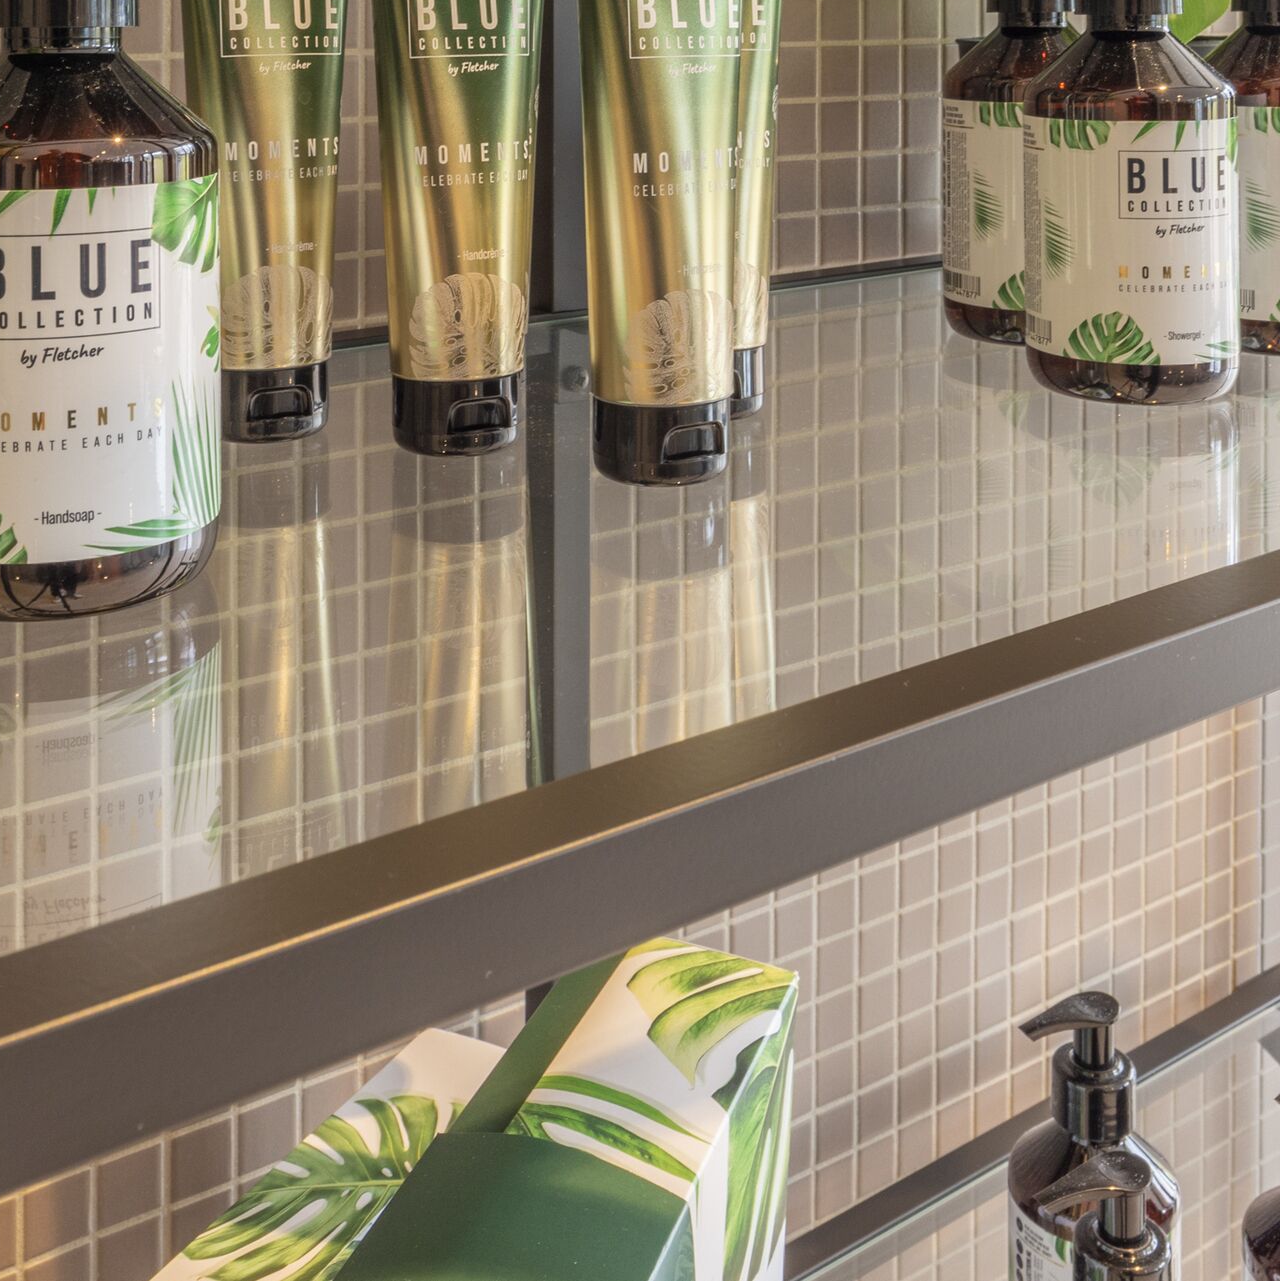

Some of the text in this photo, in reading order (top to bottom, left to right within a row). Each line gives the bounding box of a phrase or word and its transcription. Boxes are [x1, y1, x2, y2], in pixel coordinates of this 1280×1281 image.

[230, 35, 339, 50] COLLECTION
[419, 35, 527, 51] COLLECTION
[639, 34, 739, 51] COLLECTION
[448, 60, 500, 76] by Fletcher
[225, 136, 339, 161] MOMENTS
[414, 140, 529, 165] MOMENTS
[417, 172, 484, 187] ELEBRATE
[1127, 154, 1226, 195] BLUE
[1155, 222, 1205, 239] by Fletcher
[1118, 283, 1185, 293] CELEBRATE
[20, 343, 105, 369] by Fletcher
[82, 430, 125, 449] EACH
[137, 425, 163, 441] DAY
